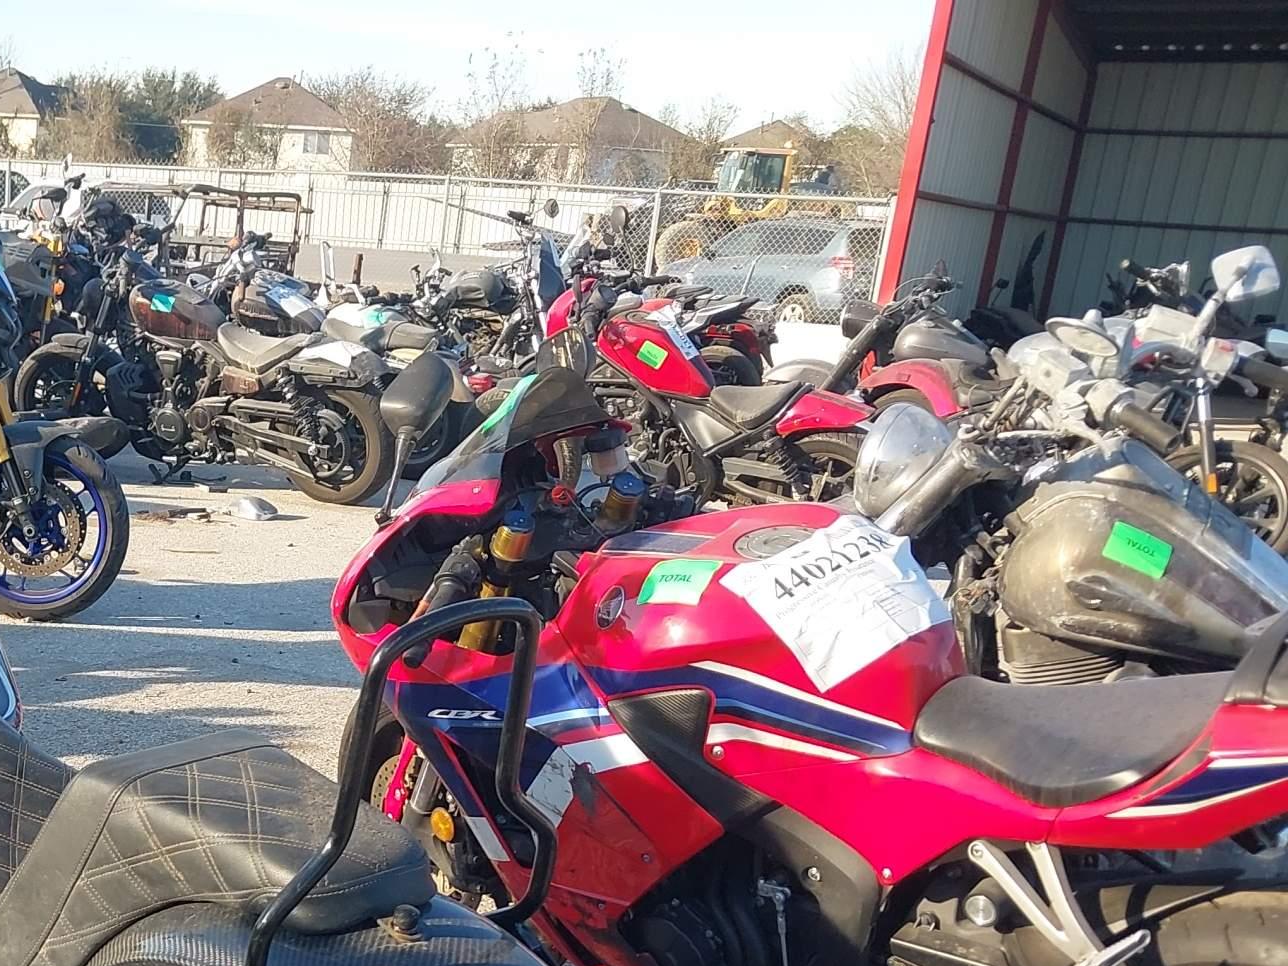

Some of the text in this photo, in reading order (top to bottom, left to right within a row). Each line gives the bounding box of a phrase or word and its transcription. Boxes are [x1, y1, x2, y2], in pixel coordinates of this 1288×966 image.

[1126, 537, 1156, 557] TOTAL
[774, 532, 895, 599] 44021238
[658, 574, 693, 583] TOTAL
[427, 708, 502, 721] CBR
